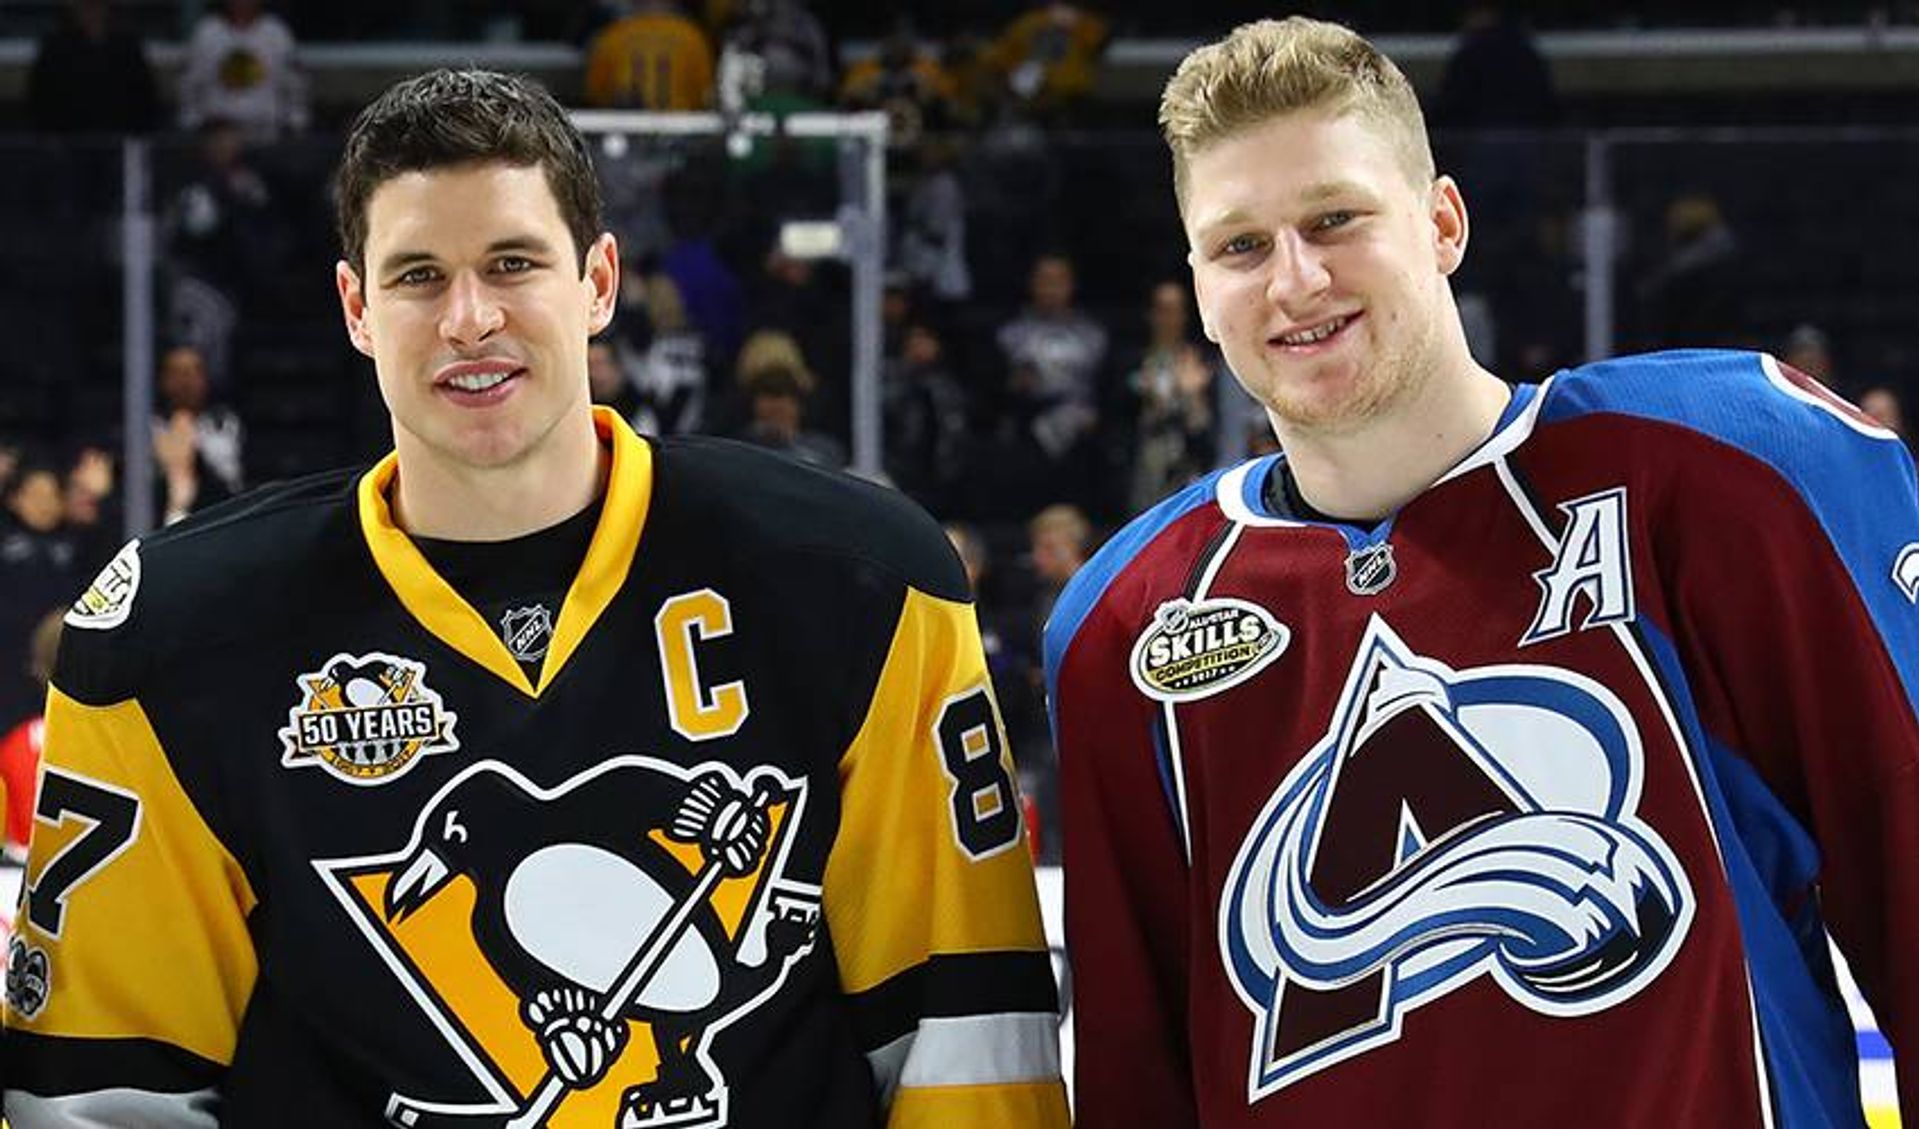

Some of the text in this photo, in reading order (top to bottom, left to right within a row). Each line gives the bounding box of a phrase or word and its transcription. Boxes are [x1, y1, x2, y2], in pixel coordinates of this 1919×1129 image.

[1517, 486, 1636, 648] A
[654, 587, 750, 742] C
[1149, 614, 1261, 667] SKILLS
[1156, 645, 1250, 682] COMPETITION
[302, 706, 433, 744] 50 YEARS
[931, 683, 1024, 863] 8
